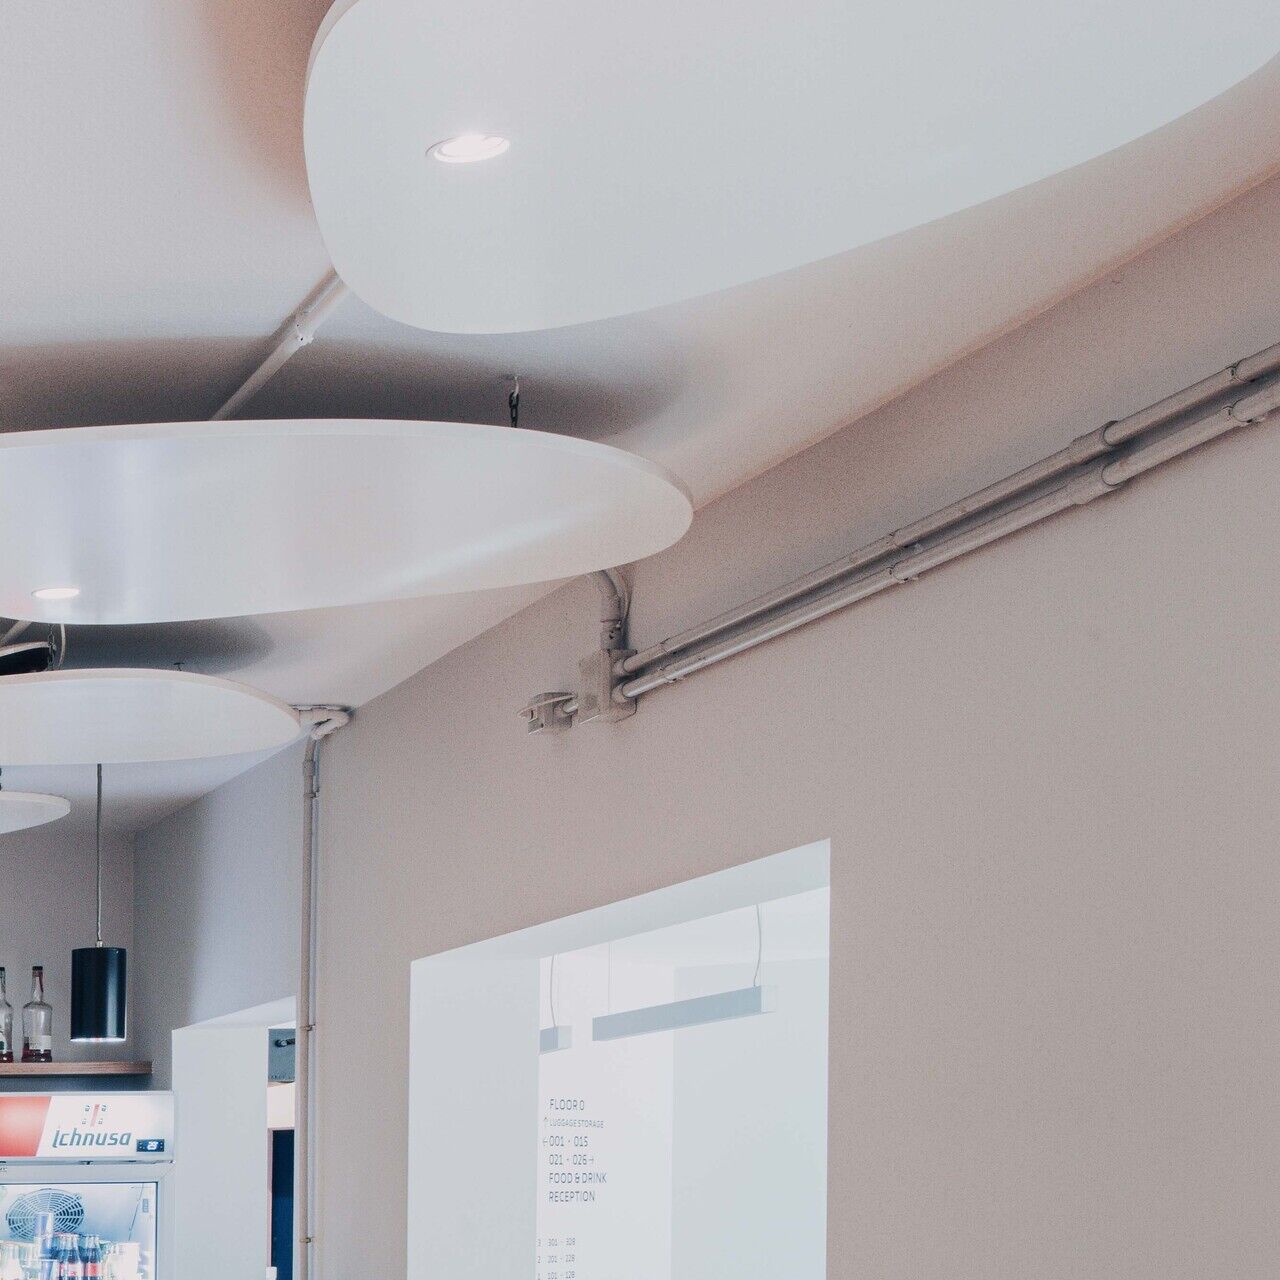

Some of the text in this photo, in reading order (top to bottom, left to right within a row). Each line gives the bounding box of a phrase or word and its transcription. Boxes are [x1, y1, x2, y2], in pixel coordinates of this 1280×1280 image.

[549, 1098, 585, 1111] FLOOR 0
[549, 1135, 564, 1147] 001
[548, 1154, 563, 1166] 021
[548, 1172, 573, 1184] FOOD
[581, 1172, 608, 1184] DRINK
[548, 1190, 595, 1203] RECEPTION
